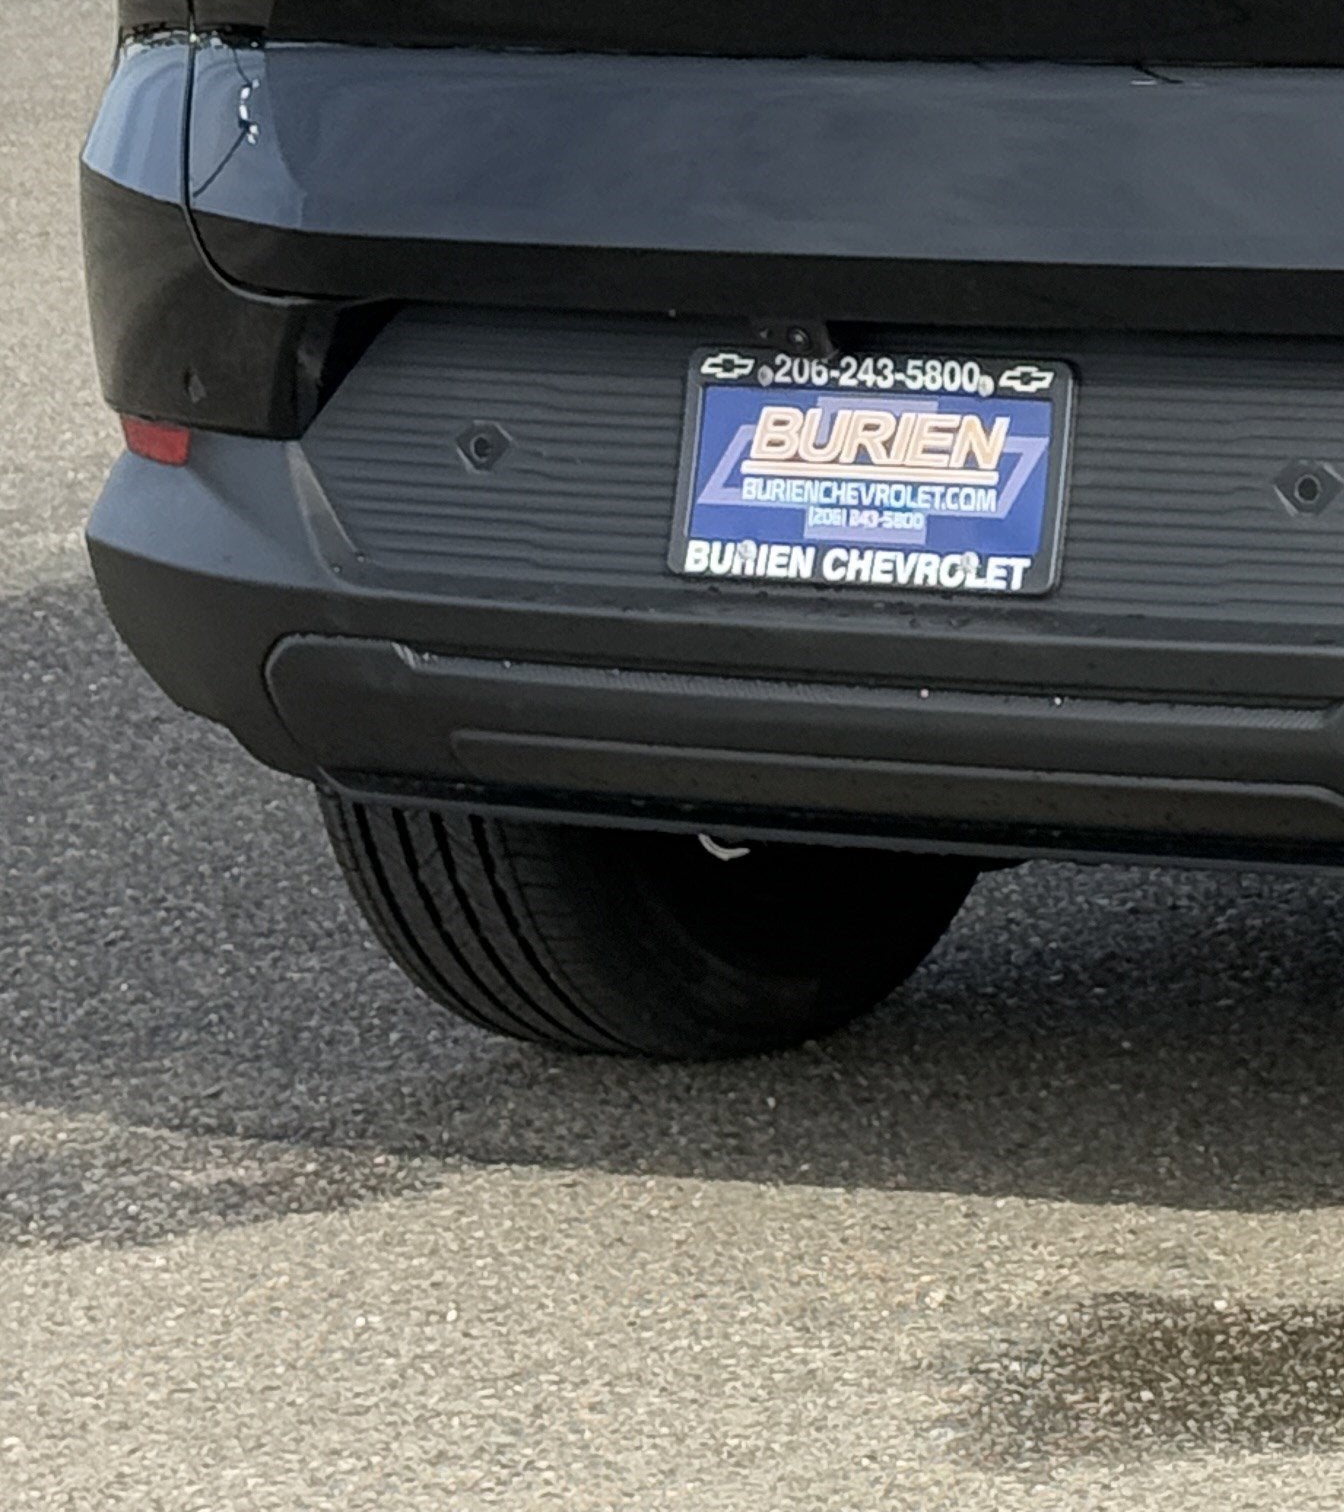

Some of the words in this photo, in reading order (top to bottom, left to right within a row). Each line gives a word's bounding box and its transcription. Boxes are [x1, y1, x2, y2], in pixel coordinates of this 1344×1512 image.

[774, 353, 980, 392] 206-243-5800
[751, 406, 1010, 470] BURIEN
[742, 477, 996, 512] BURIENCHEVROLET.COM
[684, 539, 815, 579] BURIEN
[822, 549, 1032, 591] CHEVROLET
